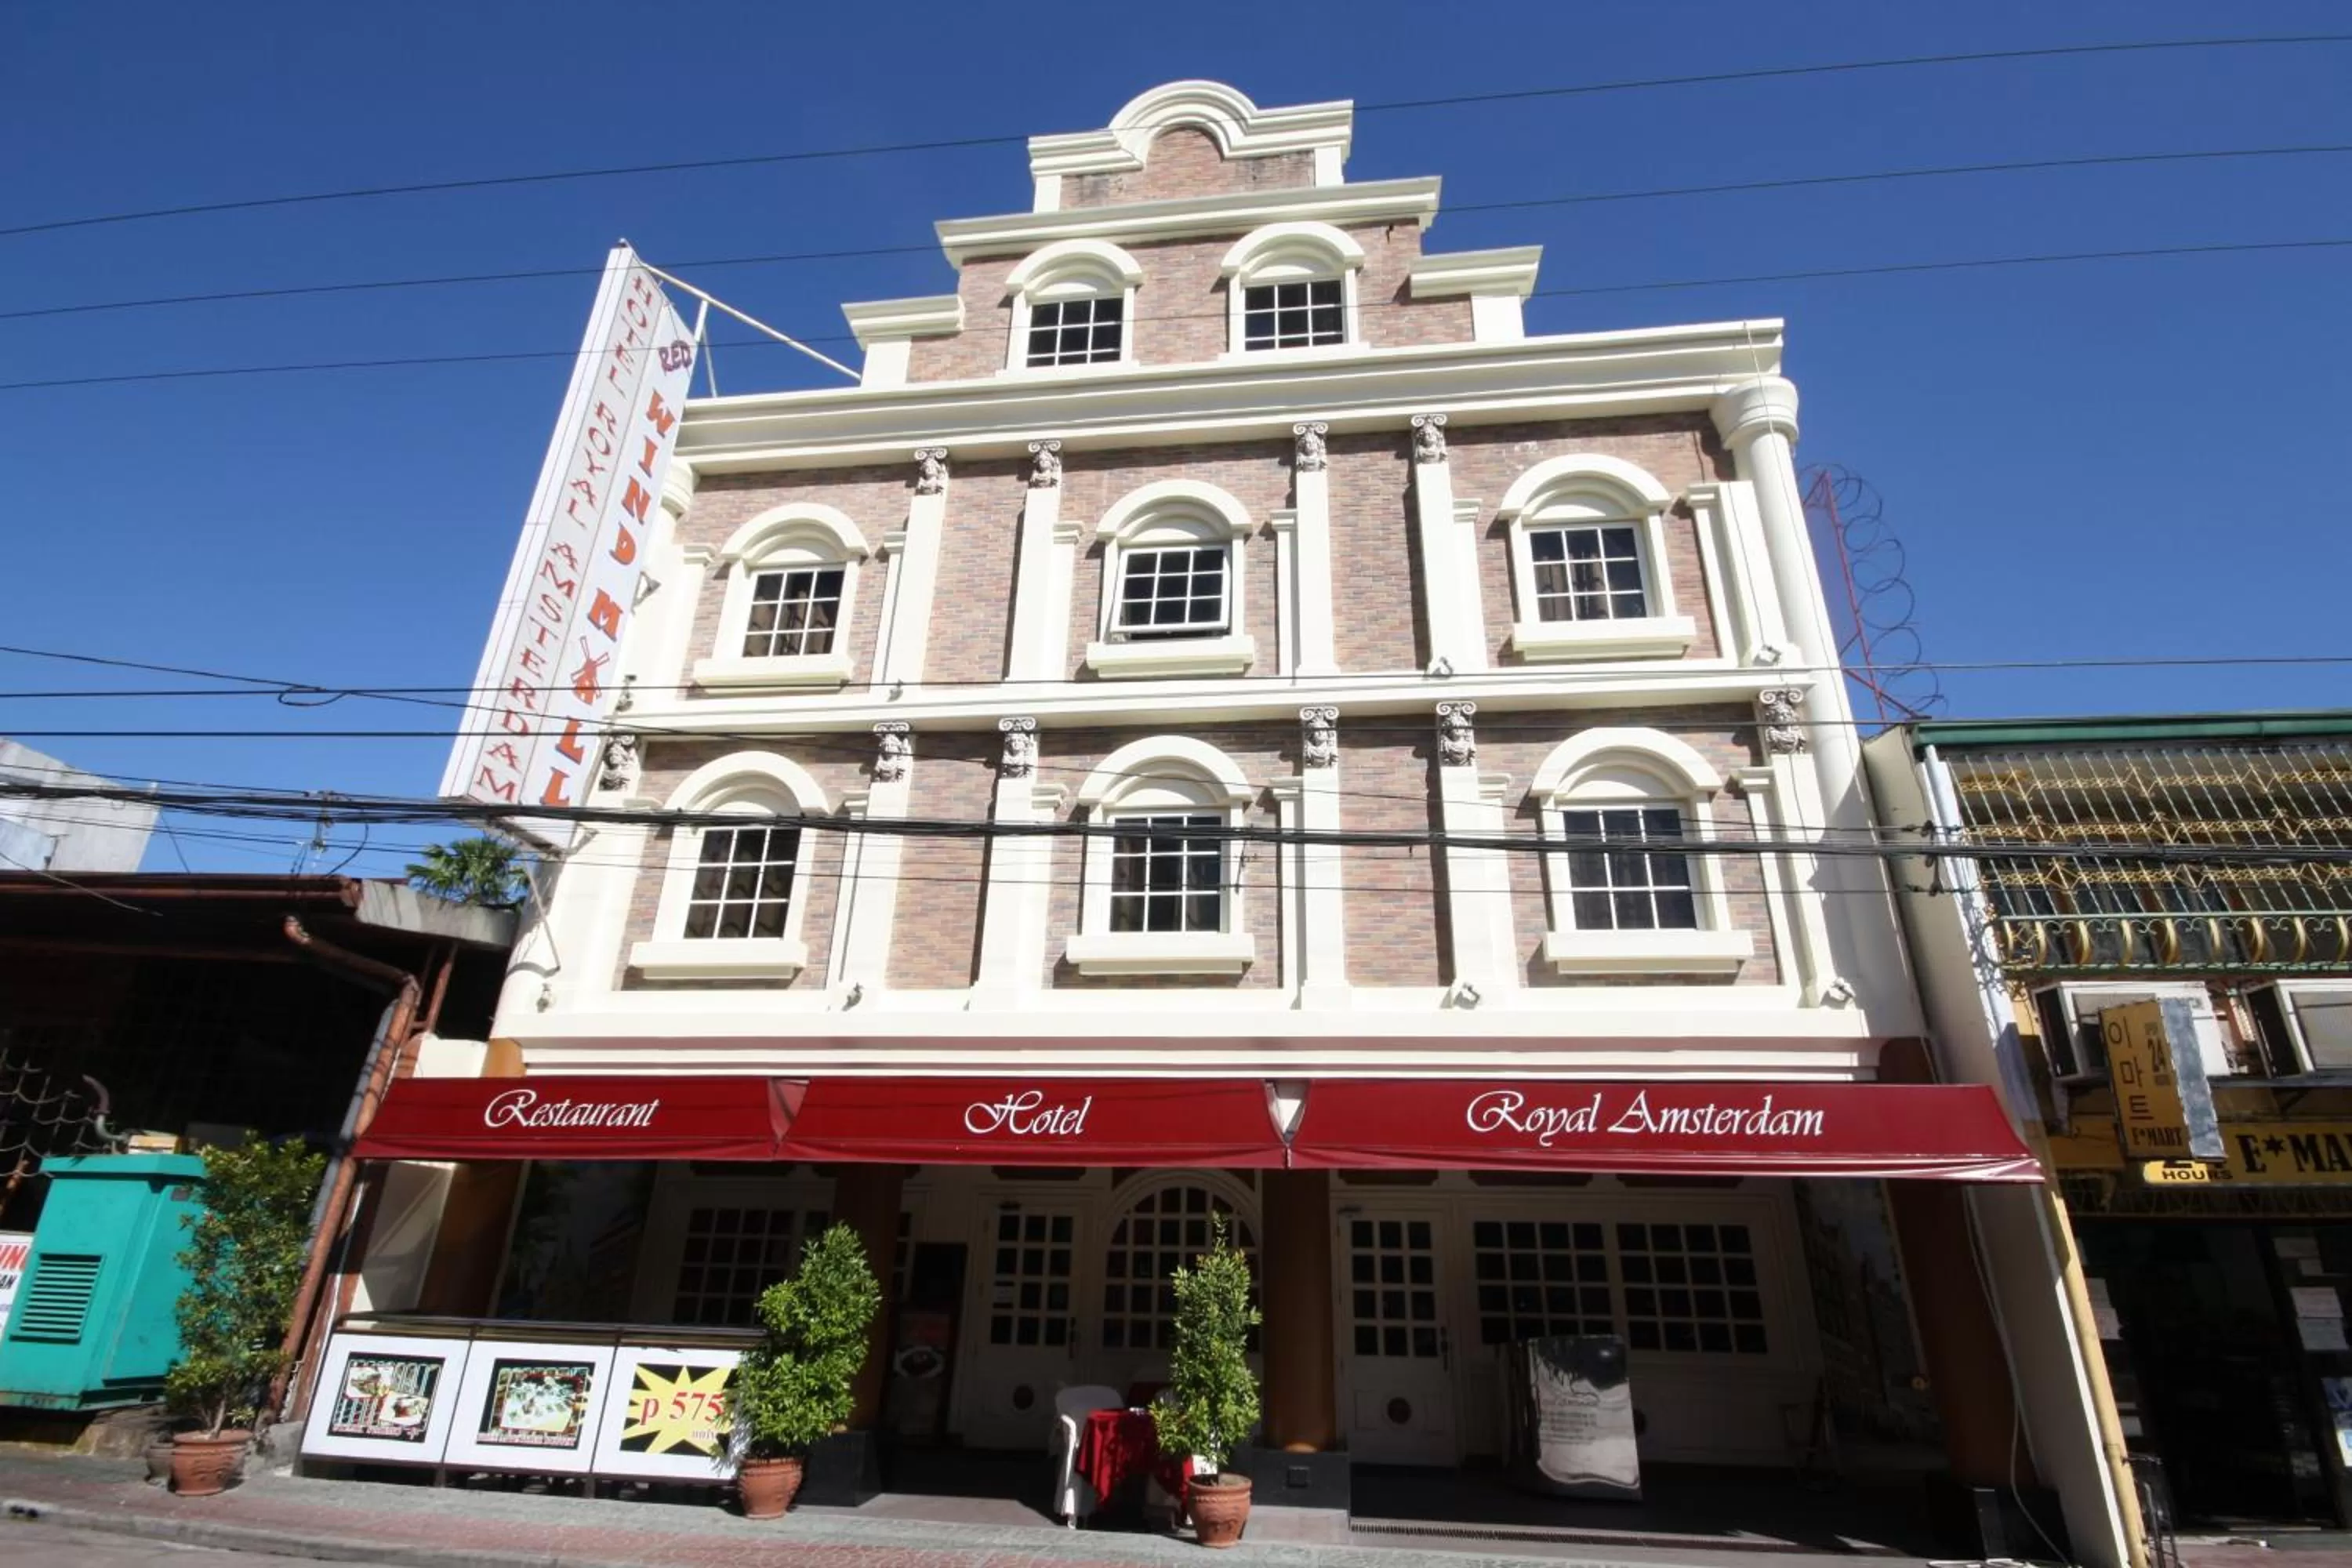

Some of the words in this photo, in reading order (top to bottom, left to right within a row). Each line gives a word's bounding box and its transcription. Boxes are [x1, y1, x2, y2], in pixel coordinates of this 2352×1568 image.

[608, 276, 653, 401] HOTEL
[658, 340, 693, 372] RED
[566, 401, 617, 530] ROYAL
[476, 541, 579, 802] AMSTERDAM
[2147, 1038, 2167, 1073] 24
[484, 1089, 659, 1127] Restaurant
[964, 1091, 1092, 1134] Hotel
[1466, 1090, 1601, 1146] Royal
[1607, 1090, 1824, 1136] Amsterdam
[2162, 1170, 2233, 1181] HOURS
[669, 1392, 725, 1423] 575
